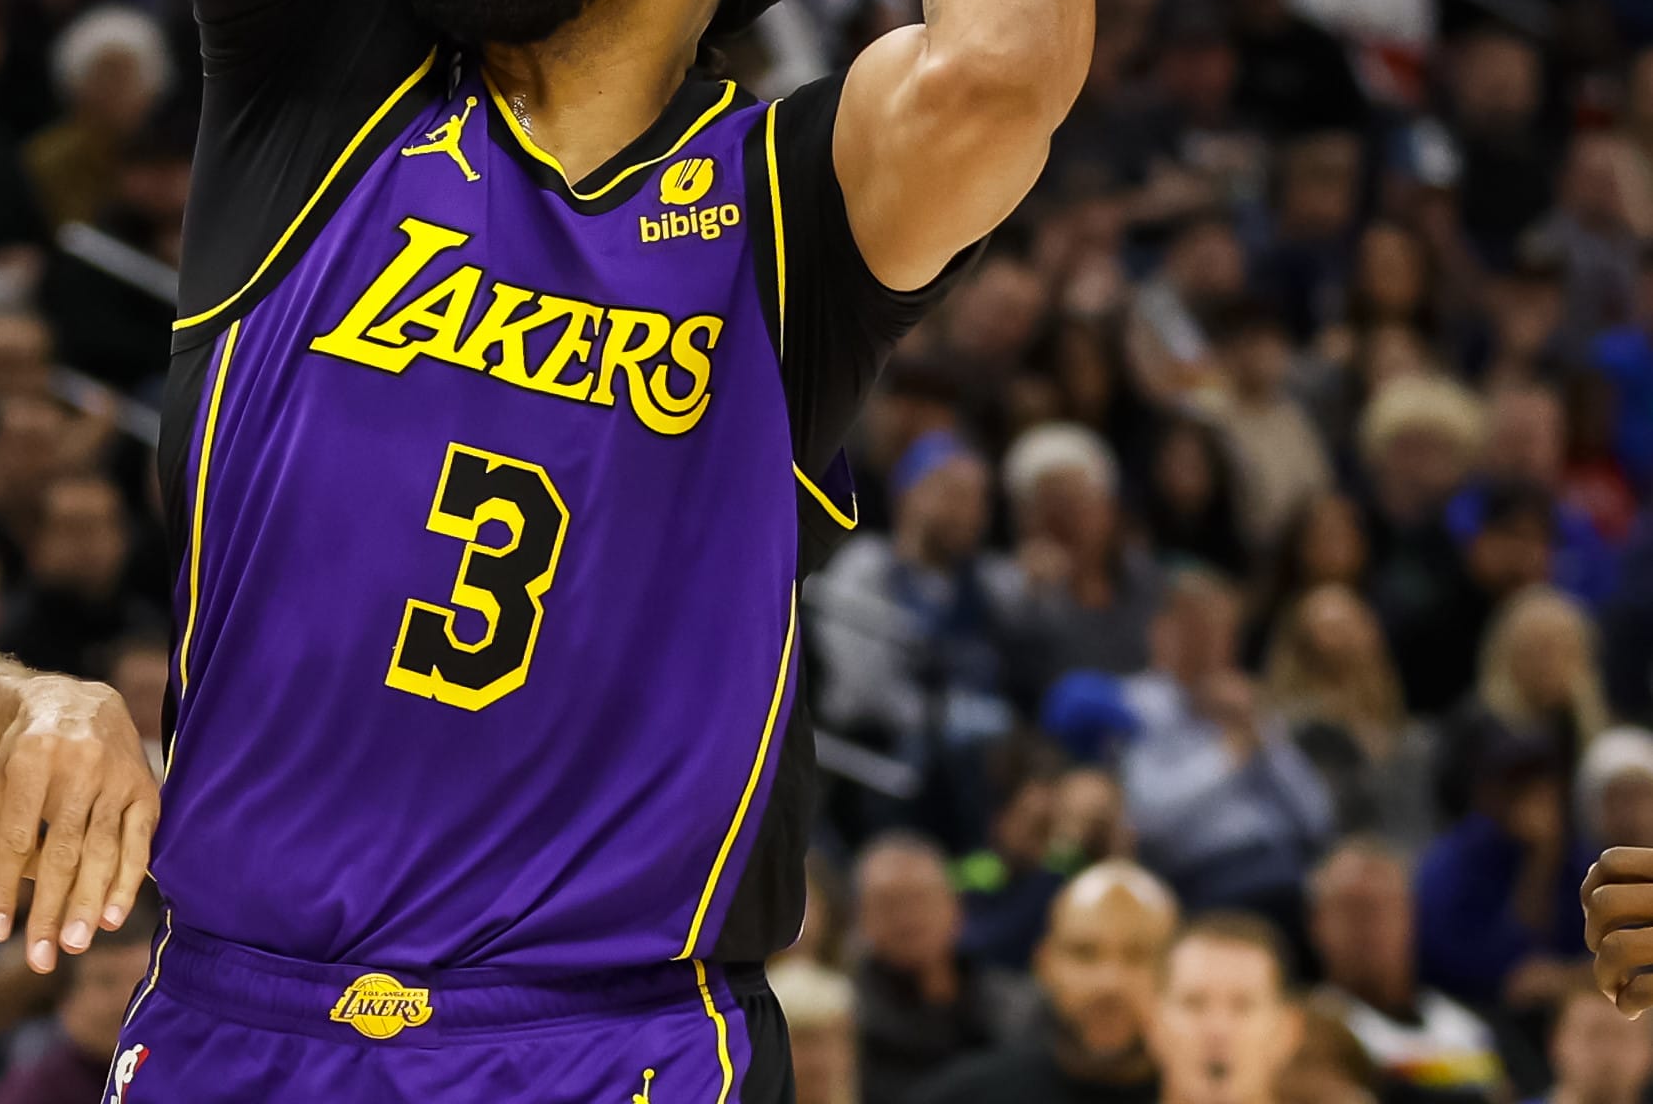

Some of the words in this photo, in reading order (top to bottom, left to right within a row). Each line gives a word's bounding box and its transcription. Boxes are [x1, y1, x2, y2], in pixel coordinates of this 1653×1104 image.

[639, 204, 741, 243] bibigo
[308, 216, 725, 436] LAKERS
[385, 441, 571, 712] 3
[335, 990, 430, 1024] LAKERS
